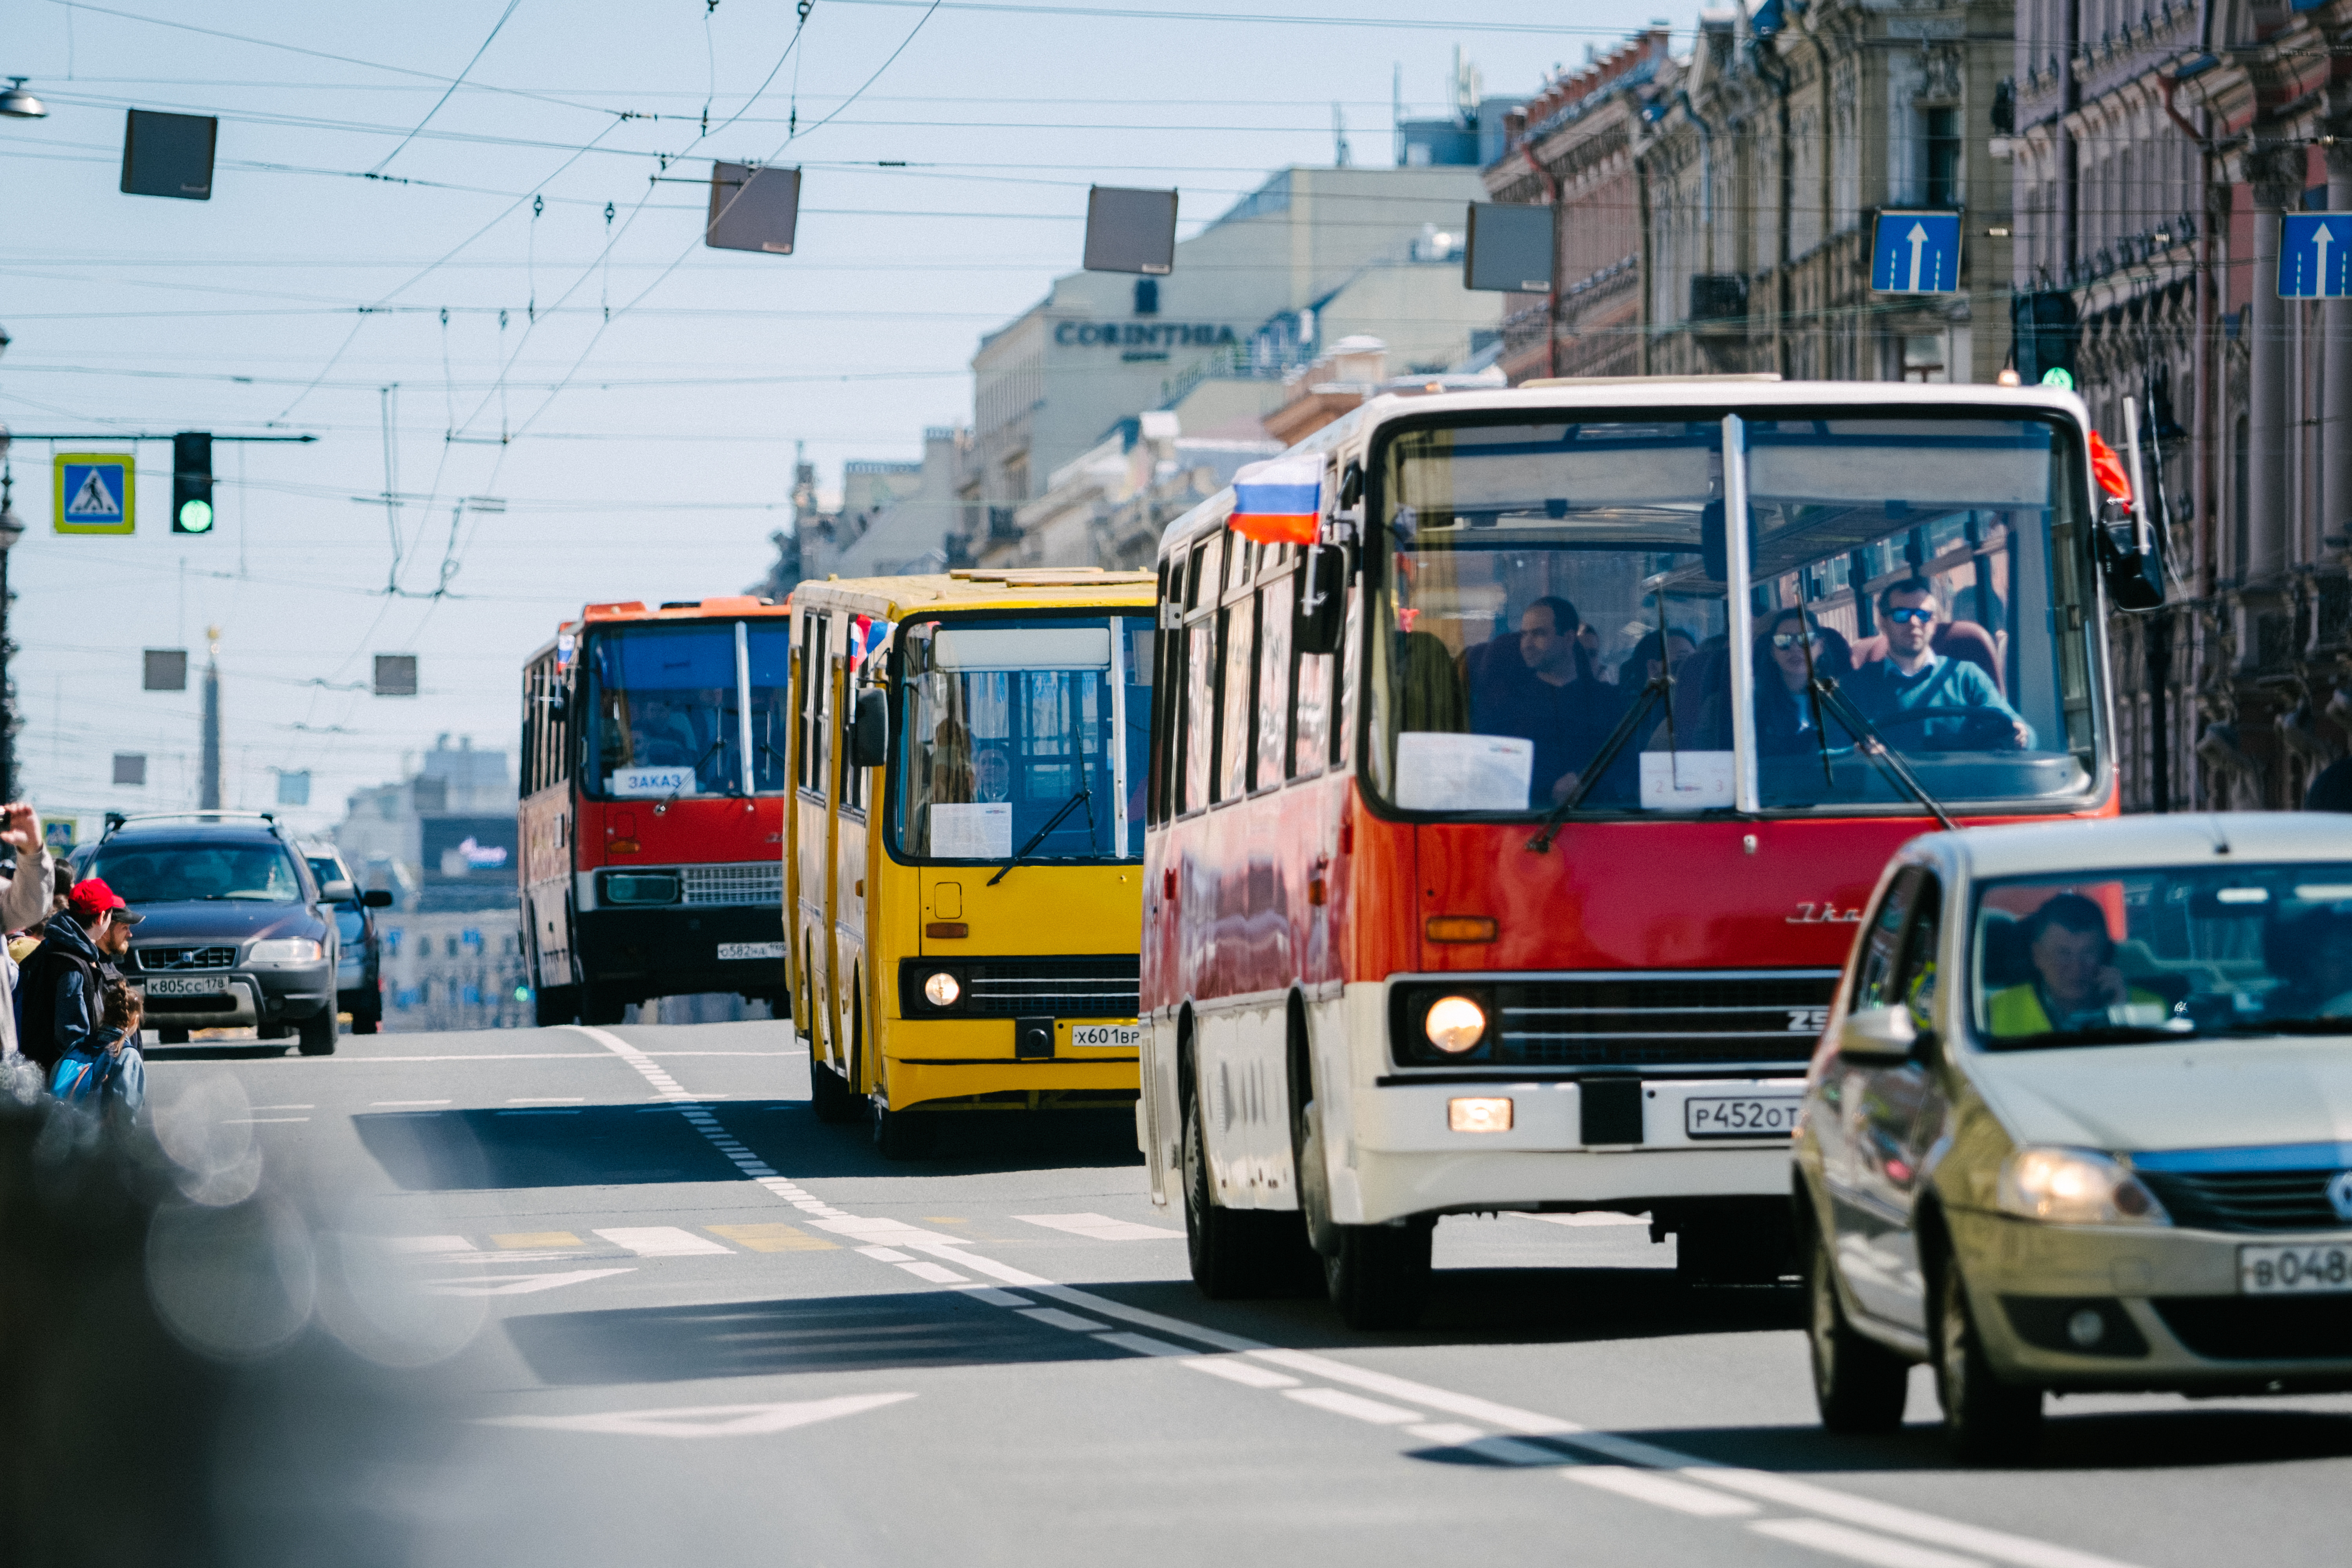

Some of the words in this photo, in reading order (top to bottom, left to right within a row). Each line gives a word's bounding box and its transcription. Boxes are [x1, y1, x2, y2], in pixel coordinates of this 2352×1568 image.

[1054, 322, 1235, 347] CORINTHIA
[628, 774, 681, 788] ЗАКАЗ
[2254, 1249, 2352, 1287] В048
